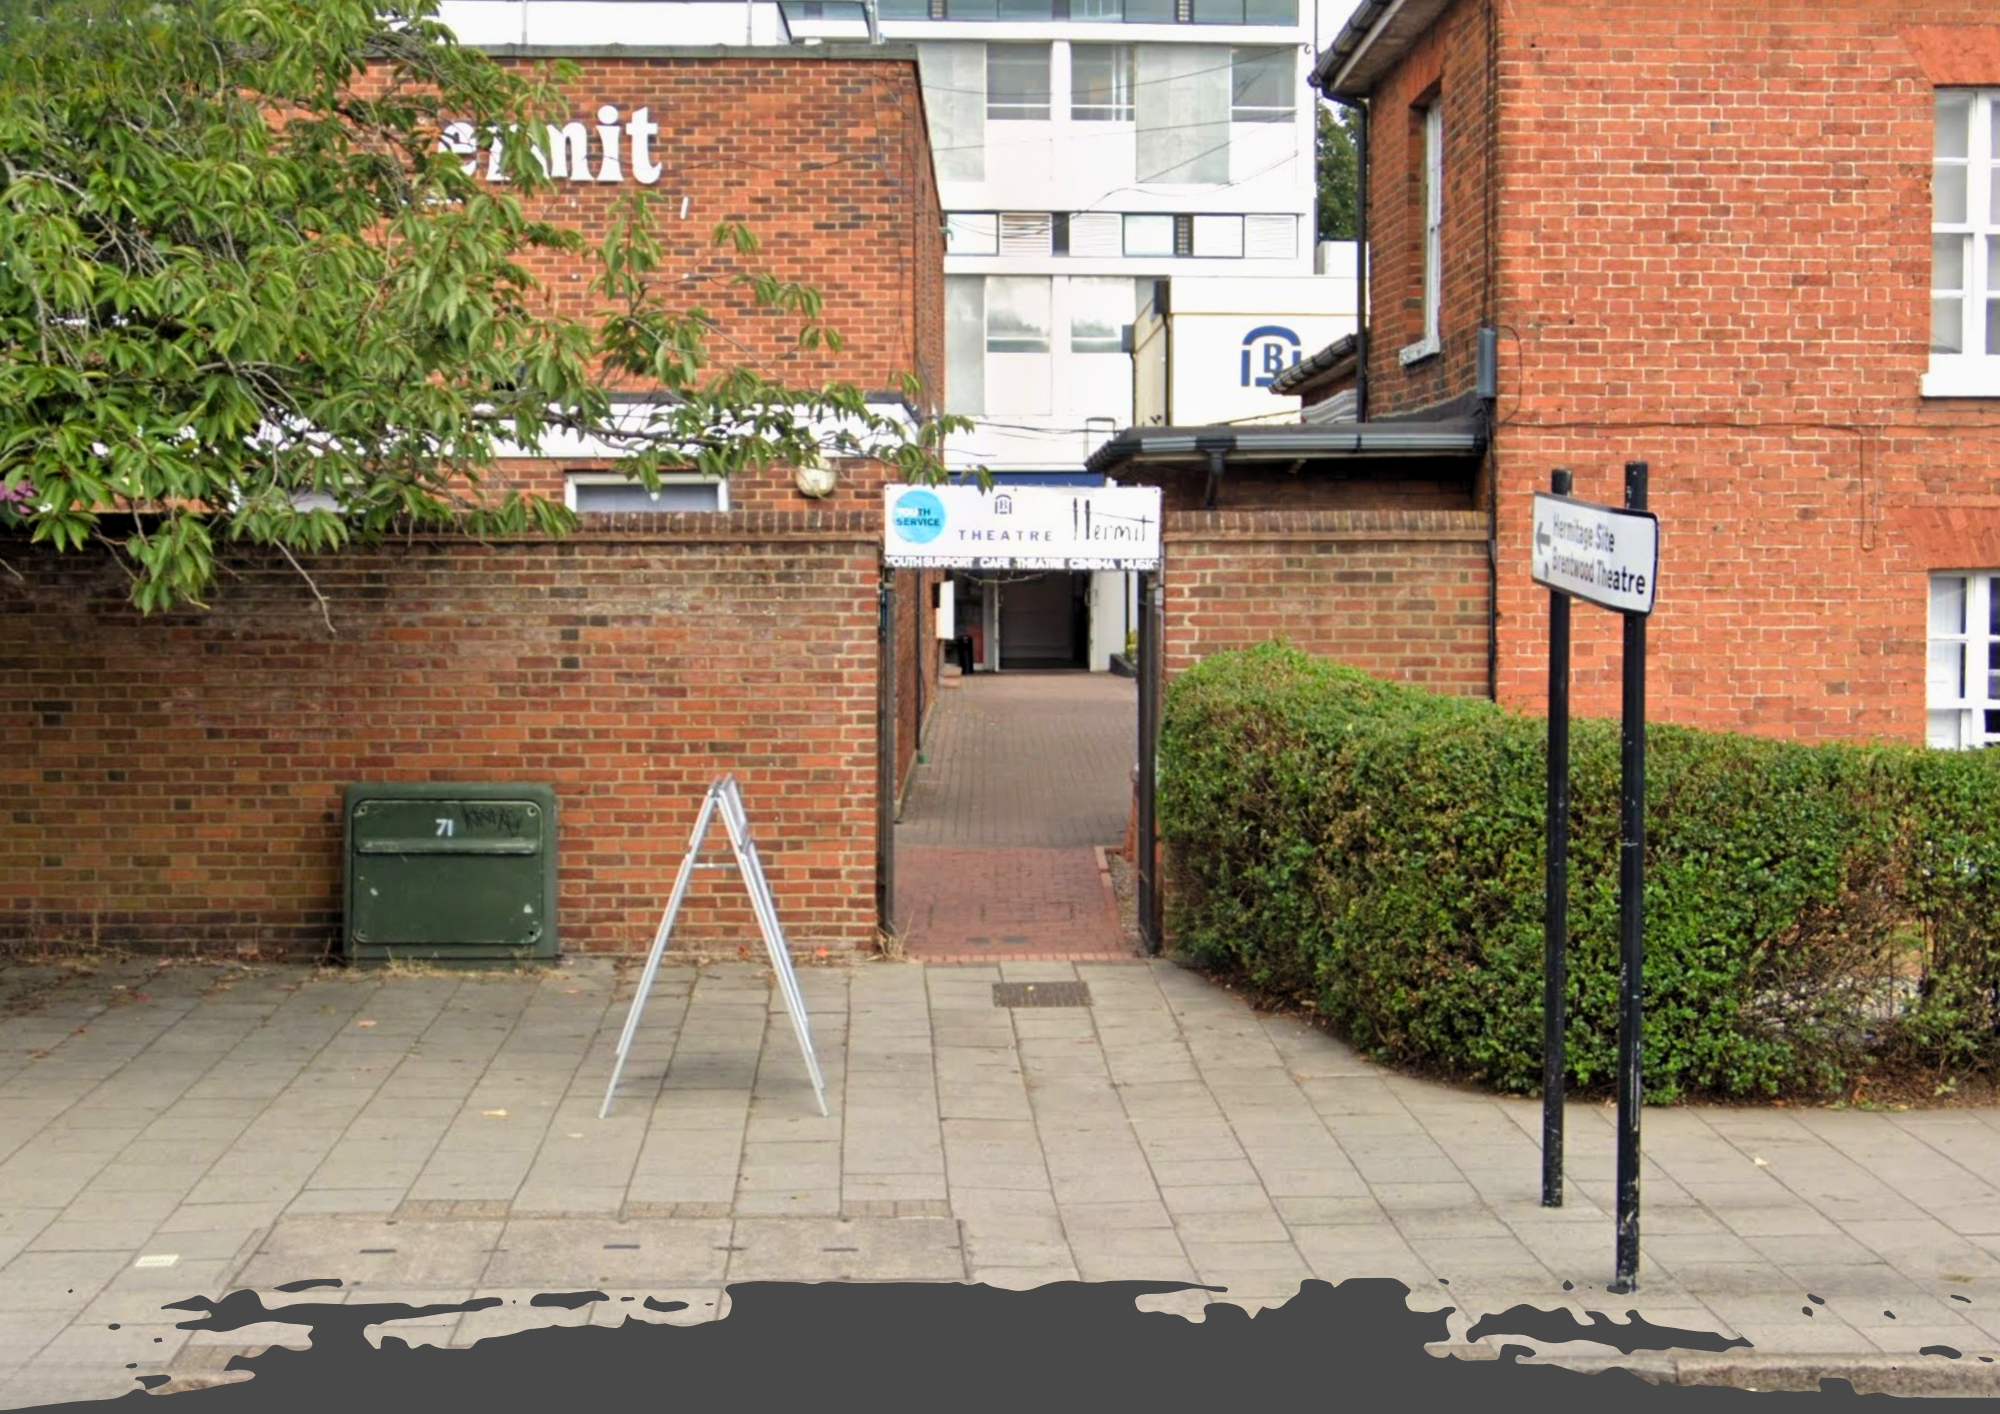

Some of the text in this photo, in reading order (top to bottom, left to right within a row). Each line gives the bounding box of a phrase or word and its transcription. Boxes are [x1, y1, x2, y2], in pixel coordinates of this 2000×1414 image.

[896, 517, 940, 527] SERVICE
[958, 529, 1053, 541] THEATRE
[1553, 512, 1615, 553] Hermitage Site
[885, 556, 922, 568] YOUTH
[923, 556, 974, 568] SUPPORT
[1015, 557, 1065, 569] THEATRE
[1069, 558, 1116, 569] CINEMA
[1121, 558, 1159, 569] MUSIC
[1552, 546, 1646, 595] Brentwood Theatre
[435, 818, 454, 836] 71
